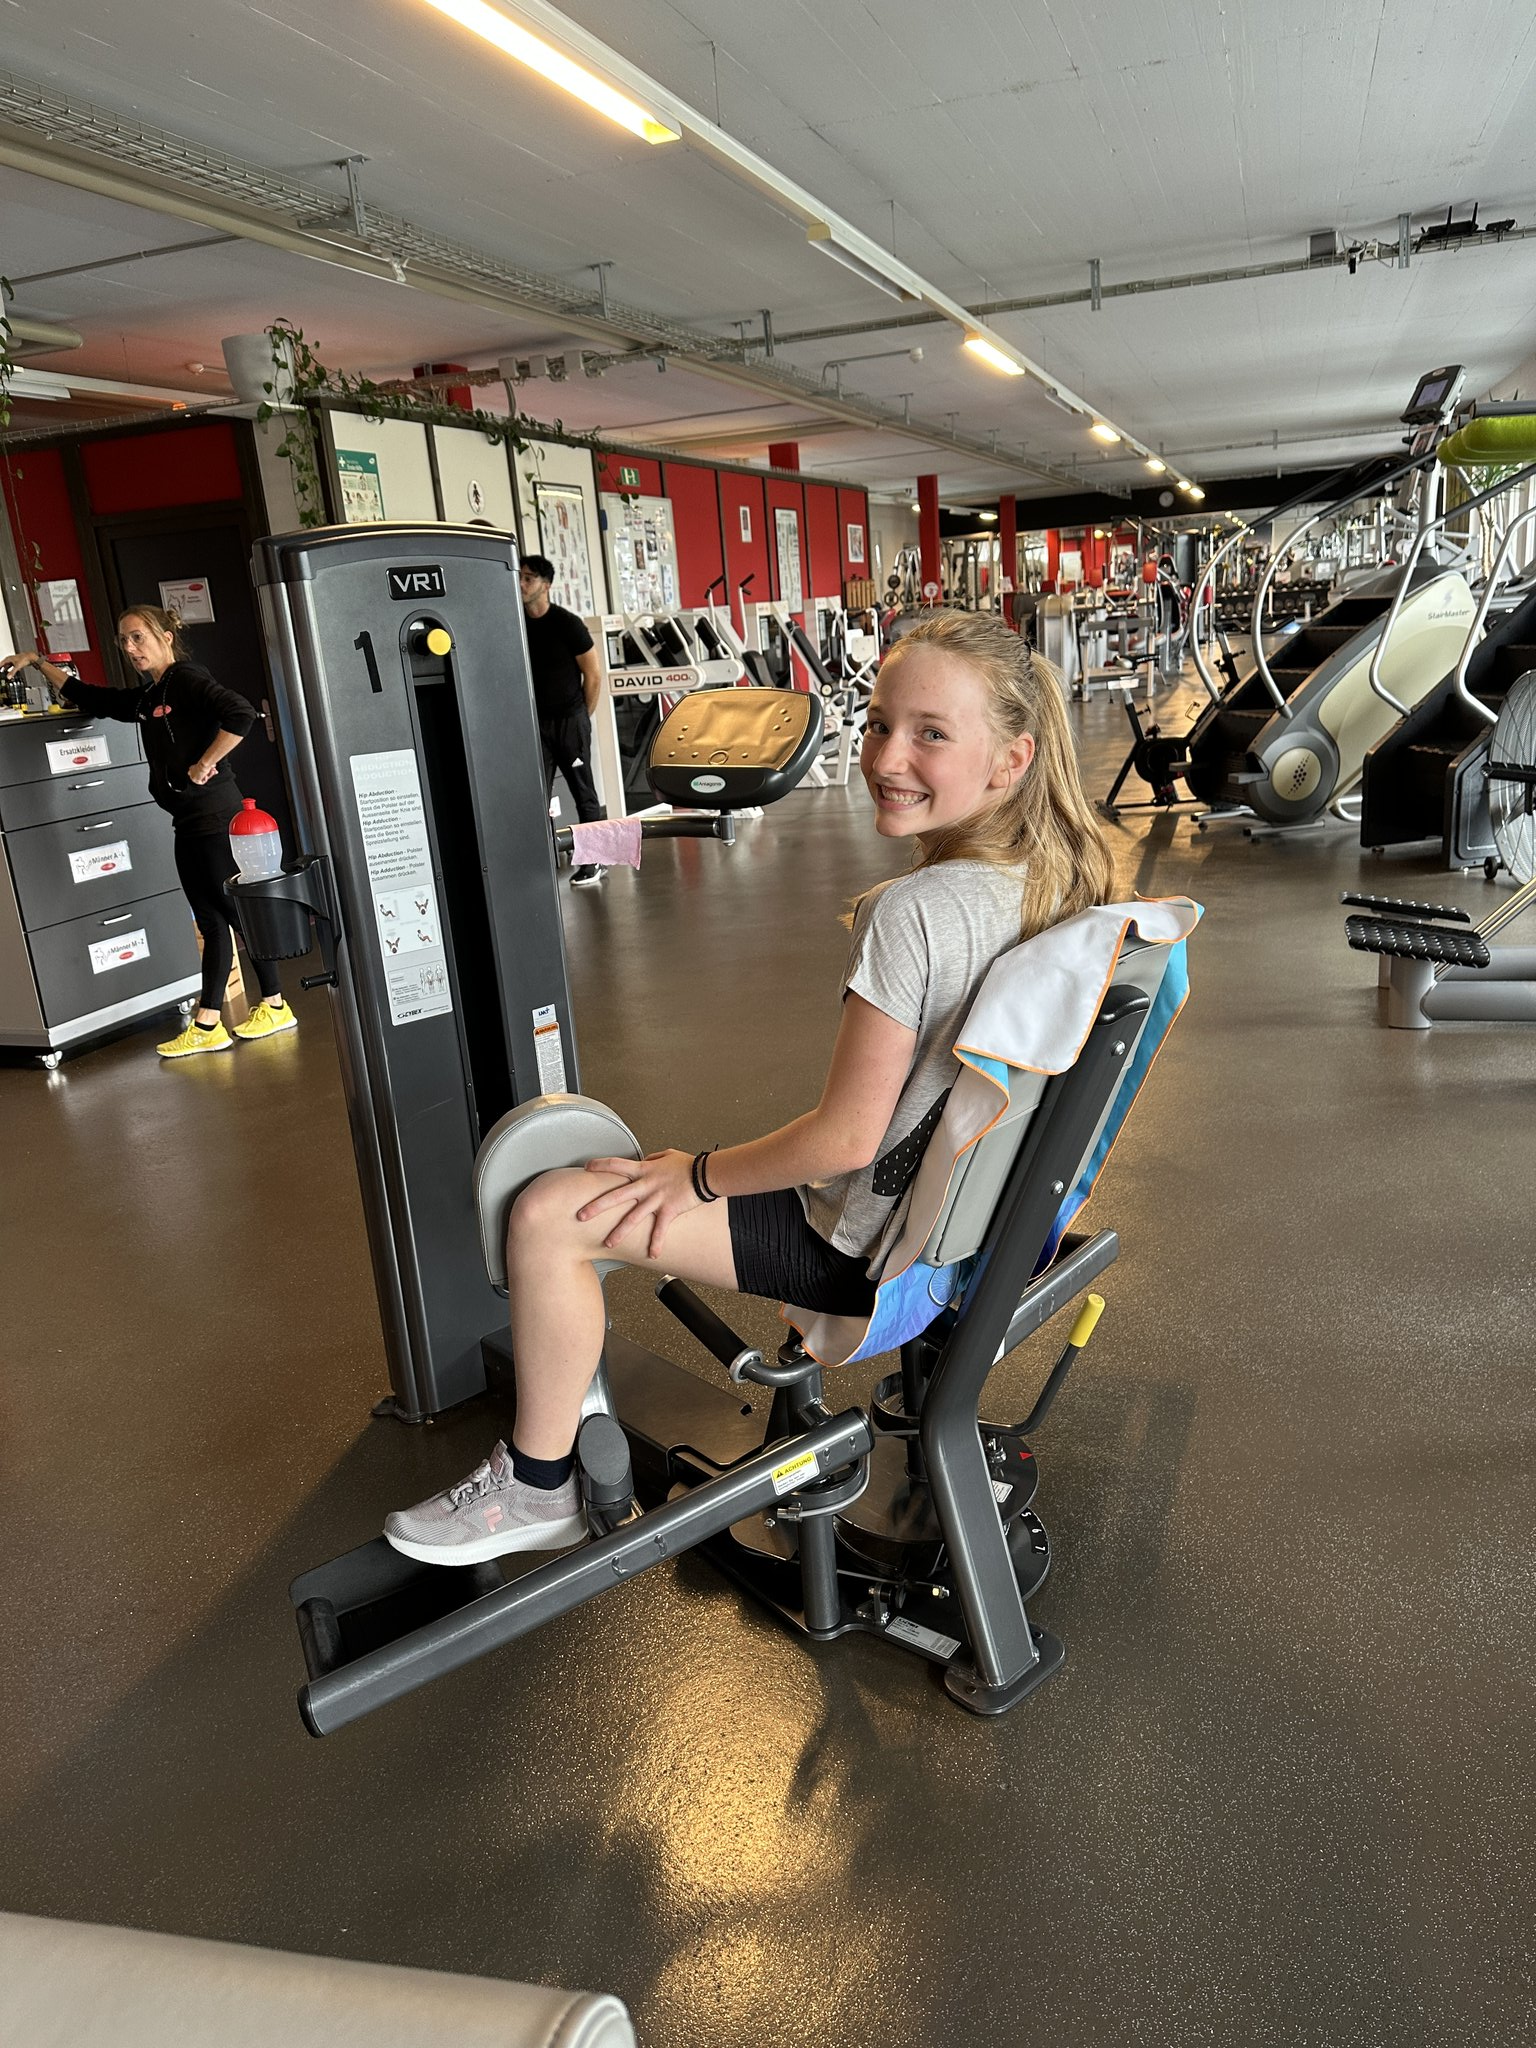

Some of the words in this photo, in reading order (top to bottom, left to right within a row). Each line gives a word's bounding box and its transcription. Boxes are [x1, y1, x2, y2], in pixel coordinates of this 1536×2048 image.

[393, 572, 440, 592] VR1
[1428, 609, 1470, 620] StairMaster
[354, 630, 382, 694] 1
[614, 676, 662, 688] DAVID
[666, 674, 688, 682] 400
[60, 745, 96, 756] Ersatzkleider
[92, 855, 112, 864] Männer
[110, 944, 130, 954] Männer
[784, 1456, 812, 1474] ACHTUNG
